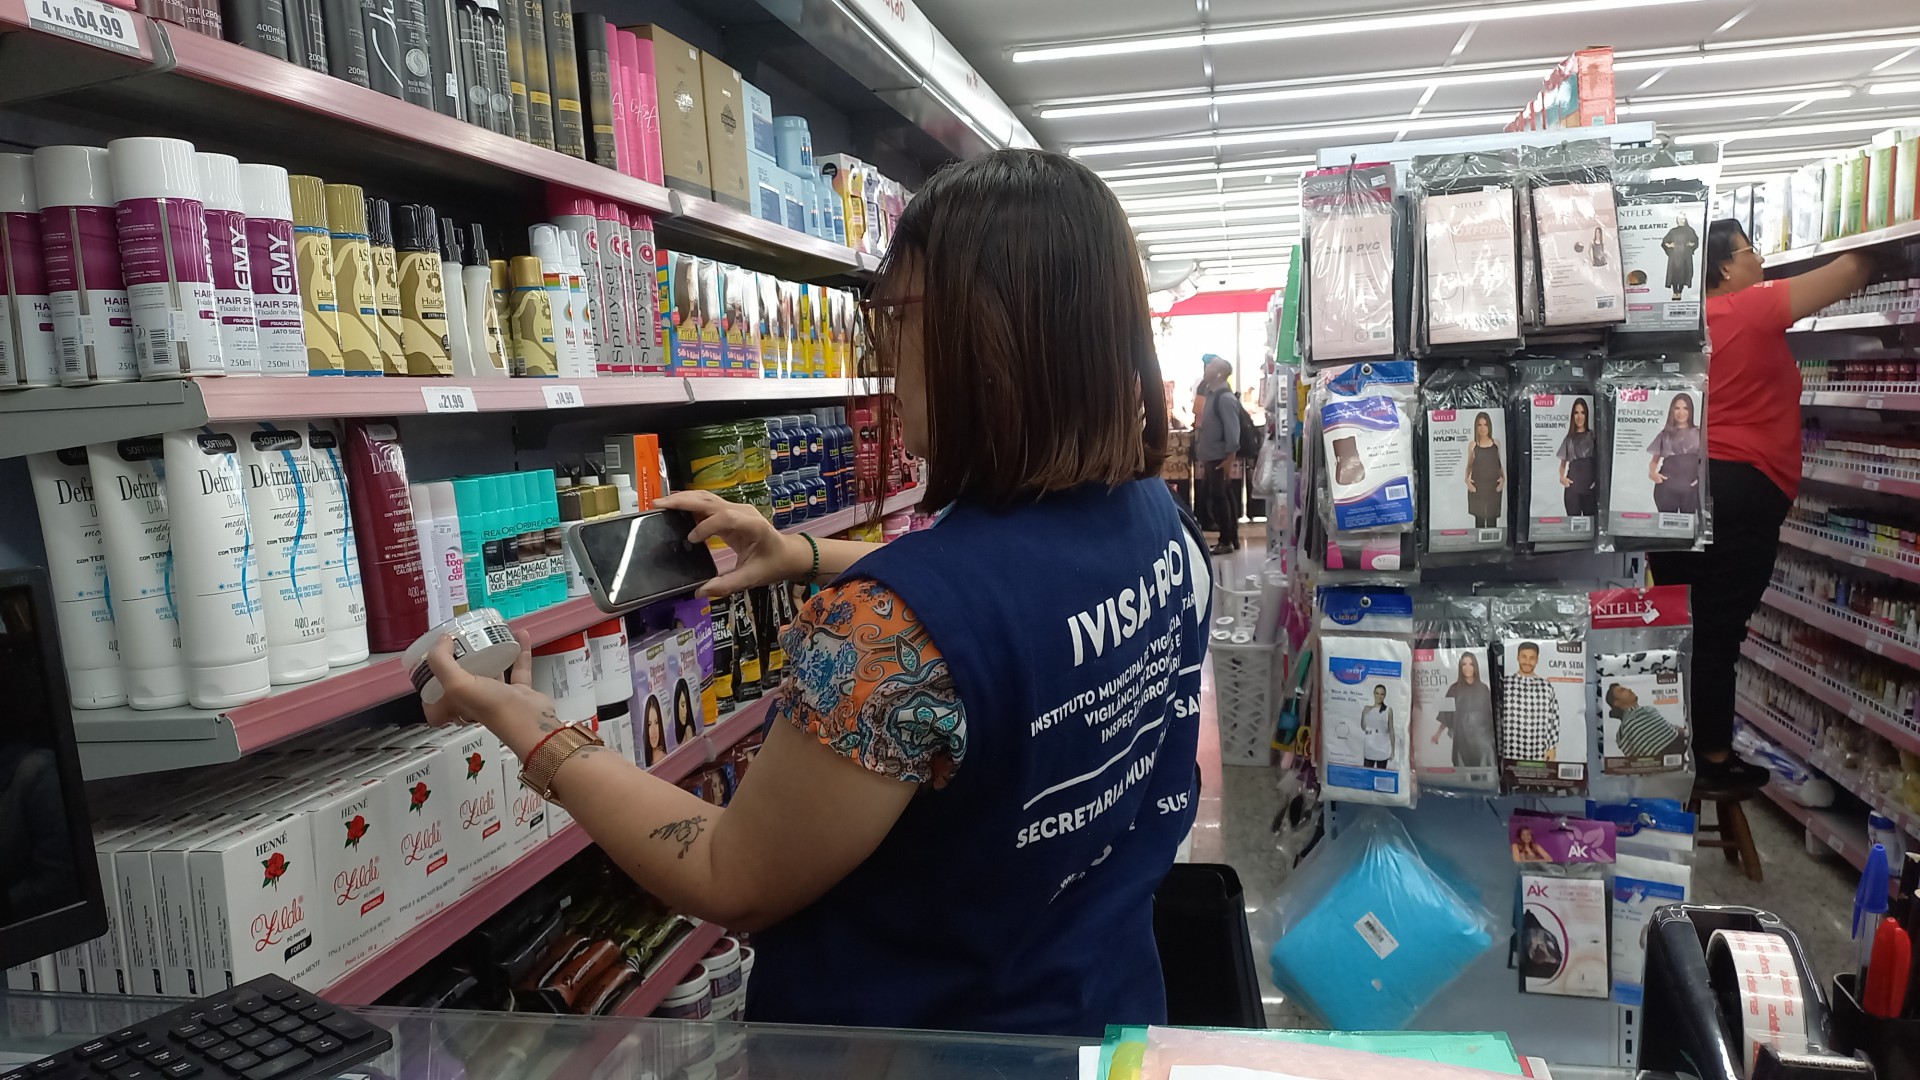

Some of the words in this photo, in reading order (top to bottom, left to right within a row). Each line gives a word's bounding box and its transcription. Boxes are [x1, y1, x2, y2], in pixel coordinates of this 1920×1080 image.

[42, 1, 51, 18] 4
[74, 7, 123, 38] 64,99
[1620, 208, 1652, 218] NTFLEX
[1357, 242, 1380, 252] PVC
[268, 233, 292, 294] EMY
[217, 296, 242, 304] HAIR
[604, 262, 624, 364] Sprayset
[444, 394, 464, 408] 21,99
[558, 392, 574, 404] 14,99
[1535, 414, 1570, 422] PENTEADOR
[1618, 408, 1664, 416] PENTEADOR
[204, 439, 232, 449] SOFTHAIR
[260, 436, 296, 446] SOFTHAIR
[248, 460, 312, 488] Defrizante
[452, 566, 462, 574] da
[1067, 540, 1184, 668] IVISA-RIO
[1596, 600, 1654, 614] NTFLEX
[294, 617, 308, 629] 400
[1030, 690, 1095, 738] INSTITUTO
[1099, 656, 1144, 701] MUNICIPAL
[1084, 682, 1140, 728] VIGILÂNCIA
[462, 736, 484, 754] HENNÉ
[406, 764, 431, 784] HENNÉ
[1016, 784, 1124, 849] SECRETARIA
[1125, 748, 1157, 790] MUN
[342, 796, 368, 818] HENNÉ
[256, 831, 288, 856] HENNÉ
[1568, 845, 1588, 858] AK
[1527, 884, 1548, 898] AK
[290, 940, 307, 954] FORTE
